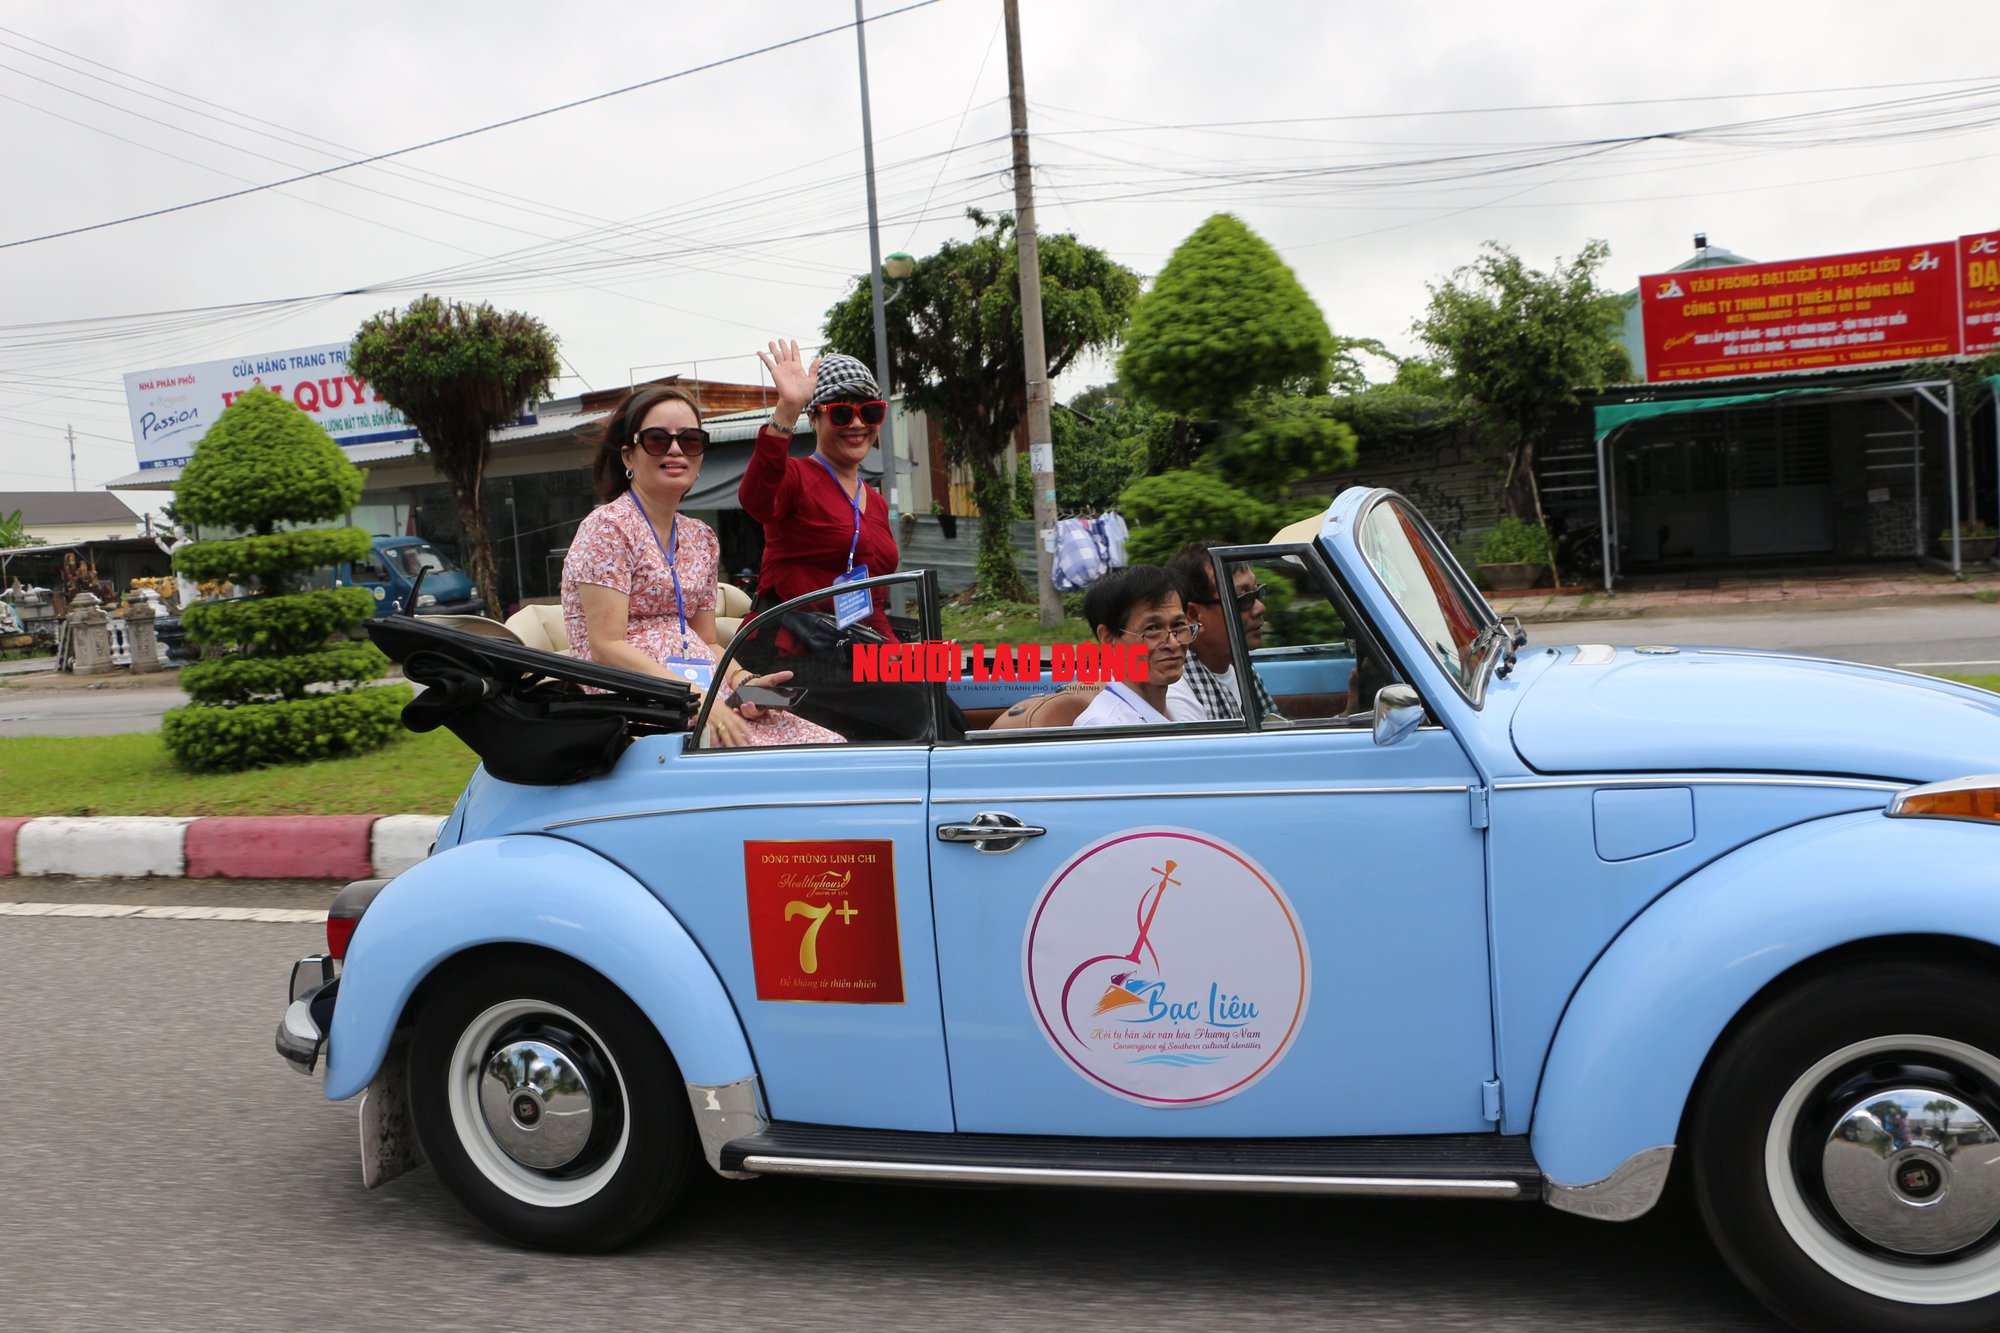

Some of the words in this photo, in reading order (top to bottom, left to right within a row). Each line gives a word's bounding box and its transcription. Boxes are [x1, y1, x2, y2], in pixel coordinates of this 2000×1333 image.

[1717, 272, 1759, 290] PHÒNG
[1842, 262, 1868, 278] BẠC
[1718, 300, 1732, 312] TY
[1734, 297, 1766, 312] TNHH
[232, 360, 254, 378] CỬA
[257, 358, 286, 376] HÀNG
[289, 353, 326, 370] TRANG
[330, 348, 348, 363] TRÍ
[139, 380, 155, 391] NHÀ
[140, 408, 198, 440] Passion
[762, 854, 789, 864] ĐÔNG
[792, 853, 827, 864] TRÙNG
[830, 854, 855, 864] LINH
[858, 854, 876, 864] CHI
[830, 978, 851, 988] thiên
[854, 980, 877, 989] nhiên
[1140, 982, 1200, 1025] Bạc
[1204, 982, 1259, 1028] Liêu
[1194, 1028, 1230, 1042] Phương
[1232, 1028, 1260, 1038] Nam
[1113, 1042, 1156, 1052] Convergence
[1158, 1042, 1166, 1052] of
[1168, 1042, 1200, 1050] Southern
[1202, 1042, 1230, 1050] cultural
[1230, 1042, 1261, 1050] identities
